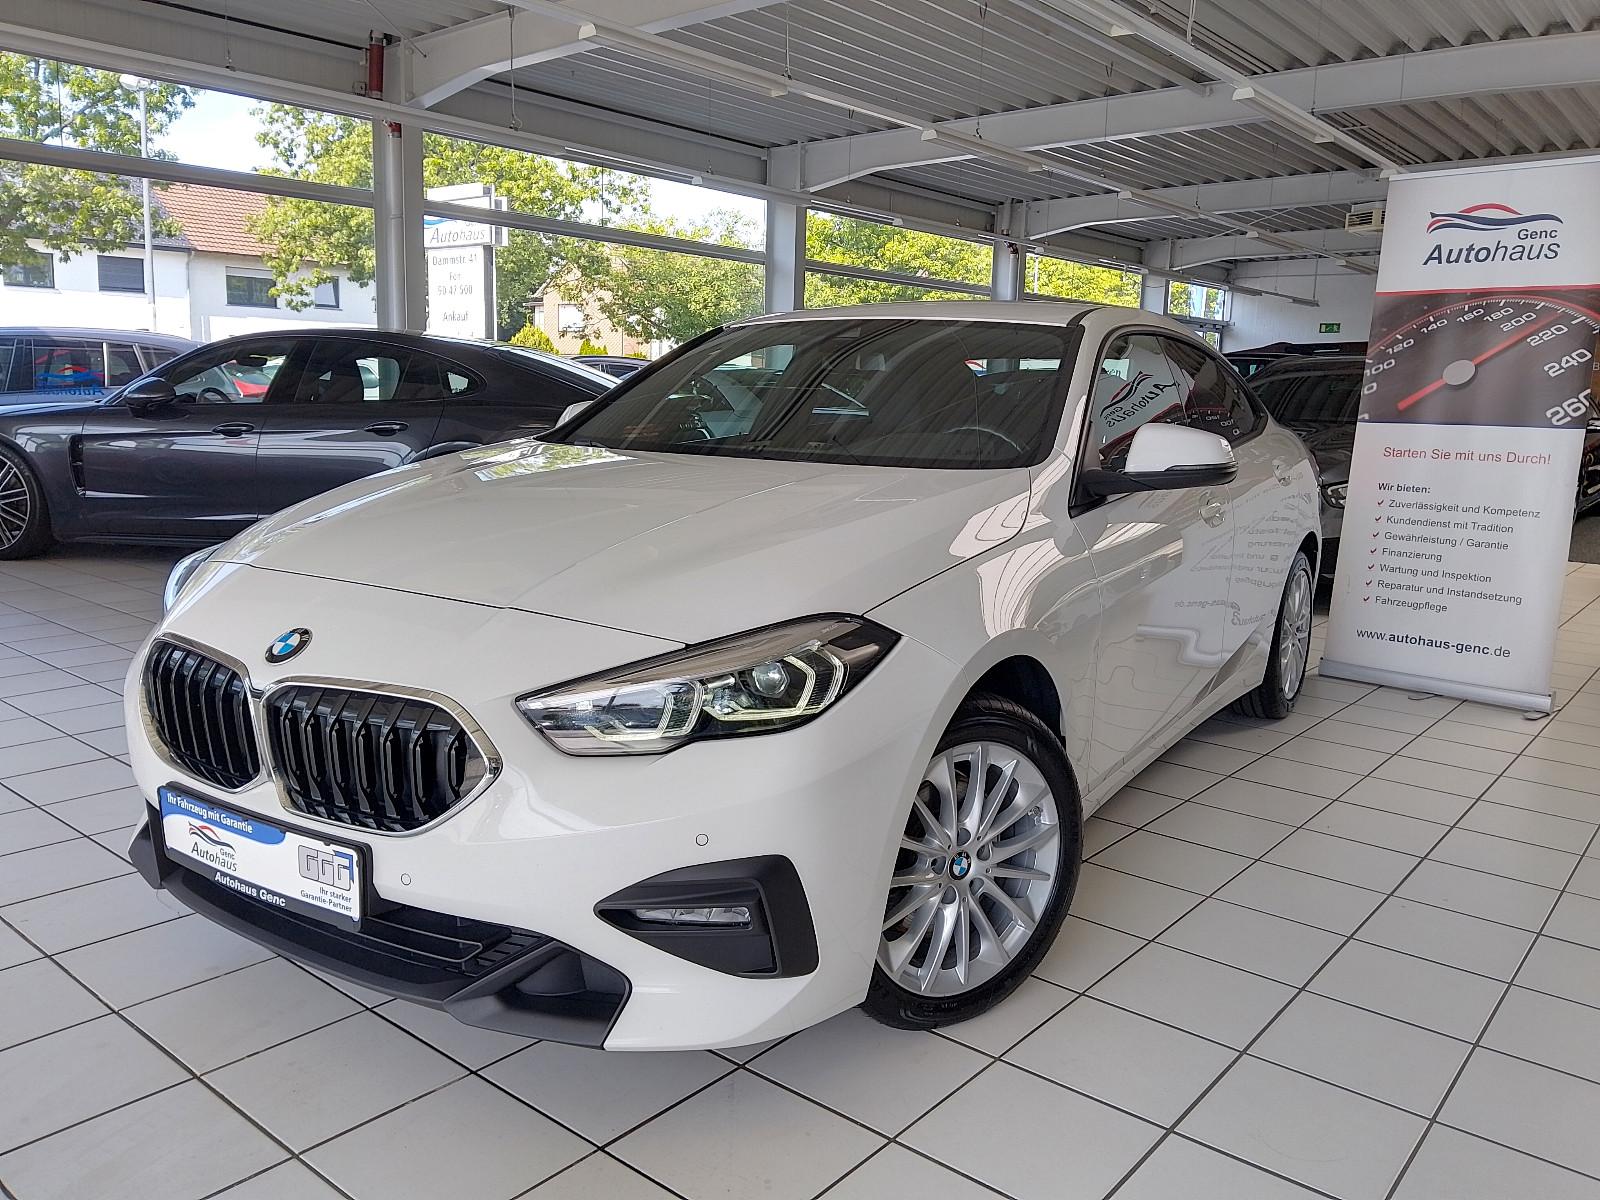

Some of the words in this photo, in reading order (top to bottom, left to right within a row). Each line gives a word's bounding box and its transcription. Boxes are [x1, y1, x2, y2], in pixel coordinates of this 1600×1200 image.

[430, 227, 485, 243] Autohaus
[1517, 228, 1558, 240] Genc
[1422, 240, 1561, 266] Autohaus
[1456, 308, 1485, 323] 160
[1483, 307, 1514, 322] 180
[1500, 312, 1537, 332] 200
[1420, 319, 1448, 334] 140
[1527, 324, 1569, 347] 220
[1385, 339, 1415, 355] 120
[1543, 349, 1592, 378] 240
[1383, 446, 1427, 459] Starten
[1431, 448, 1451, 460] Sie
[1455, 450, 1474, 461] mit
[1478, 453, 1502, 463] uns
[1506, 451, 1551, 465] Durch!
[1378, 482, 1395, 491] Wir
[1396, 484, 1431, 494] bieten:
[1388, 499, 1459, 513] Zuverlässigkeit
[1461, 505, 1480, 514] und
[1483, 505, 1541, 519] Kompetenz
[1386, 516, 1451, 529] Kundendienst
[1453, 521, 1468, 530] mit
[1471, 521, 1514, 533] Tradition
[1384, 531, 1457, 547] Gewährleistung
[1466, 538, 1509, 551] Garantie
[1381, 547, 1443, 562] Finanzierung
[1379, 563, 1419, 577] Wartung
[1421, 569, 1439, 578] und
[1442, 570, 1492, 583] Inspektion
[1377, 580, 1424, 593] Reparatur
[1426, 586, 1444, 595] und
[1446, 587, 1523, 606] Instandsetzung
[1375, 595, 1448, 613] Fahrzeugpflege
[1356, 628, 1511, 658] www.autohaus-genc.de
[167, 793, 177, 804] Ihr
[177, 796, 207, 819] Fahrzeug
[207, 809, 220, 822] mit
[220, 814, 253, 834] Garantie
[191, 841, 238, 872] Autohaus
[219, 848, 235, 860] Genc
[215, 871, 257, 897] Autohaus
[259, 889, 286, 907] Genc
[319, 886, 329, 894] Ihr
[329, 890, 352, 903] starker
[300, 889, 352, 913] Garantie-Partner
